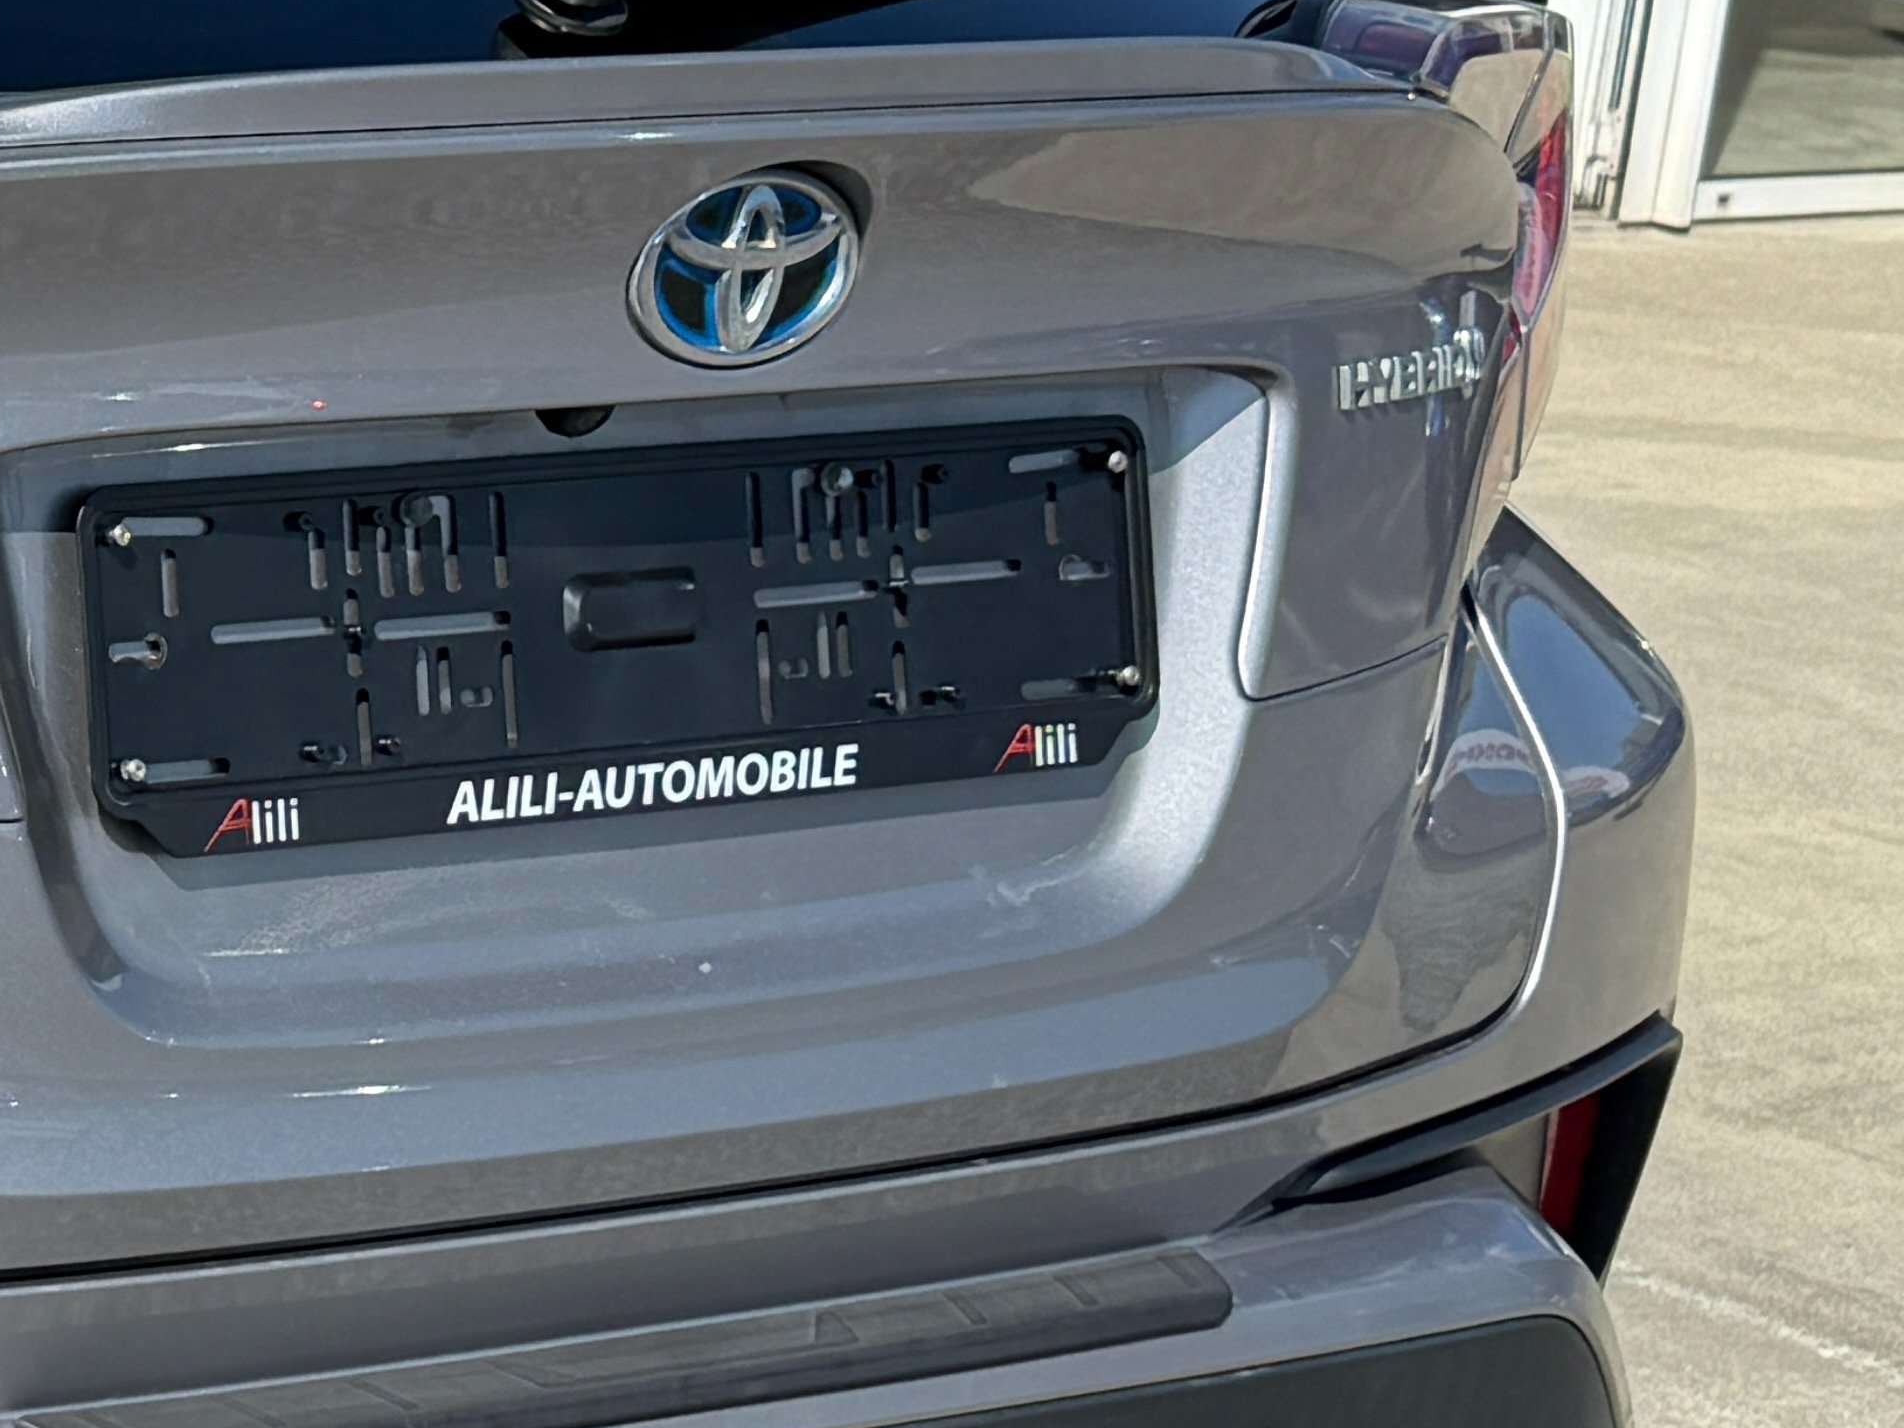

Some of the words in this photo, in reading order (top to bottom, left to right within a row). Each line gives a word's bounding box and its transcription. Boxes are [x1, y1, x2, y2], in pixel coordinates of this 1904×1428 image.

[993, 722, 1079, 774] Alili
[445, 742, 860, 826] ALILI-AUTOMOBILE
[204, 797, 300, 853] Alili
